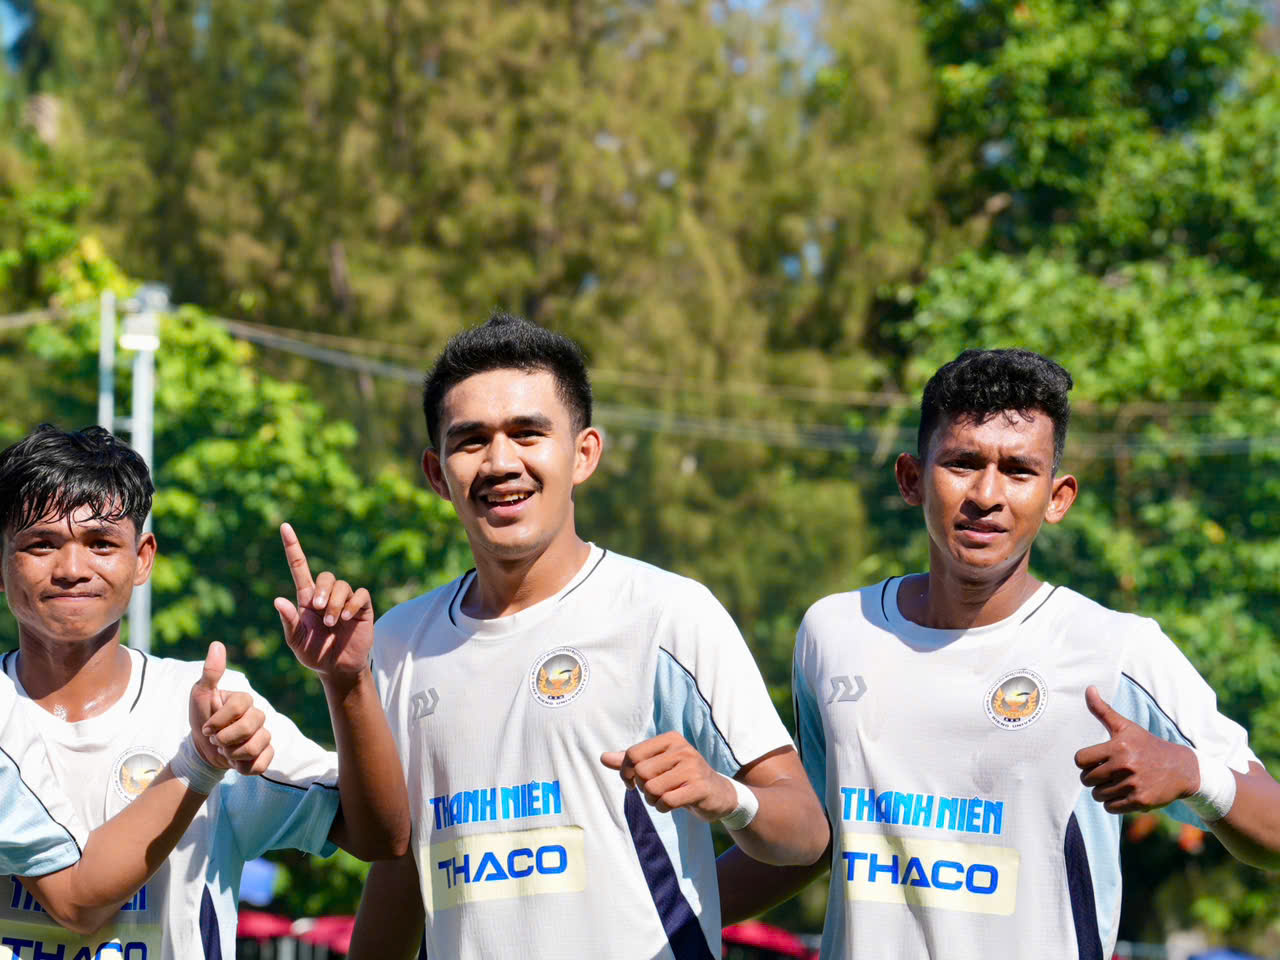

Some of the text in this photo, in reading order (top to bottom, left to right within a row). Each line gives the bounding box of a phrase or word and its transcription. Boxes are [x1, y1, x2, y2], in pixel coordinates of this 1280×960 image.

[430, 780, 562, 830] THANH NIÊN
[840, 787, 1004, 835] THANH NIÊN
[438, 844, 568, 889] THACO
[842, 852, 999, 895] THACO
